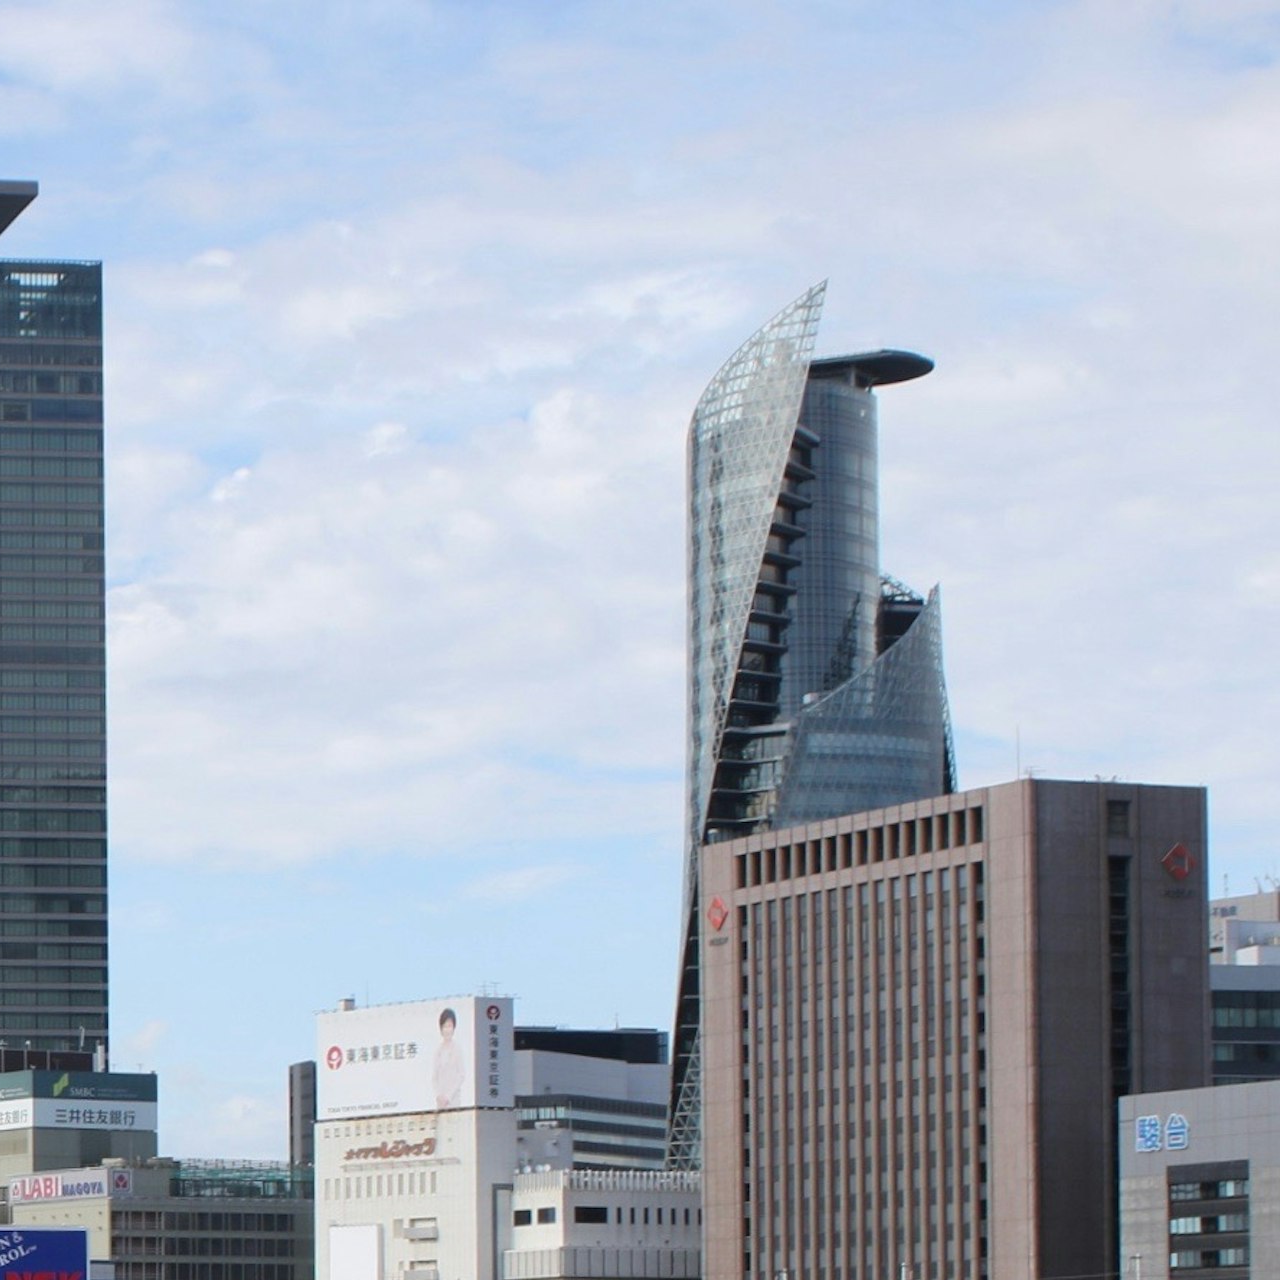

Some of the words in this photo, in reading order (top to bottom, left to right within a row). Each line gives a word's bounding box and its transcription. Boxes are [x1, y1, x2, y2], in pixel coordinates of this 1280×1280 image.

[346, 1043, 418, 1065] 東海東京証券
[488, 1024, 499, 1096] 東海東京証券
[70, 1087, 95, 1097] SMBC
[55, 1109, 136, 1126] 三井住友銀行
[1136, 1113, 1189, 1152] 駿台
[22, 1176, 59, 1200] LABI
[62, 1181, 105, 1196] NAGOYA
[13, 1231, 23, 1243] &
